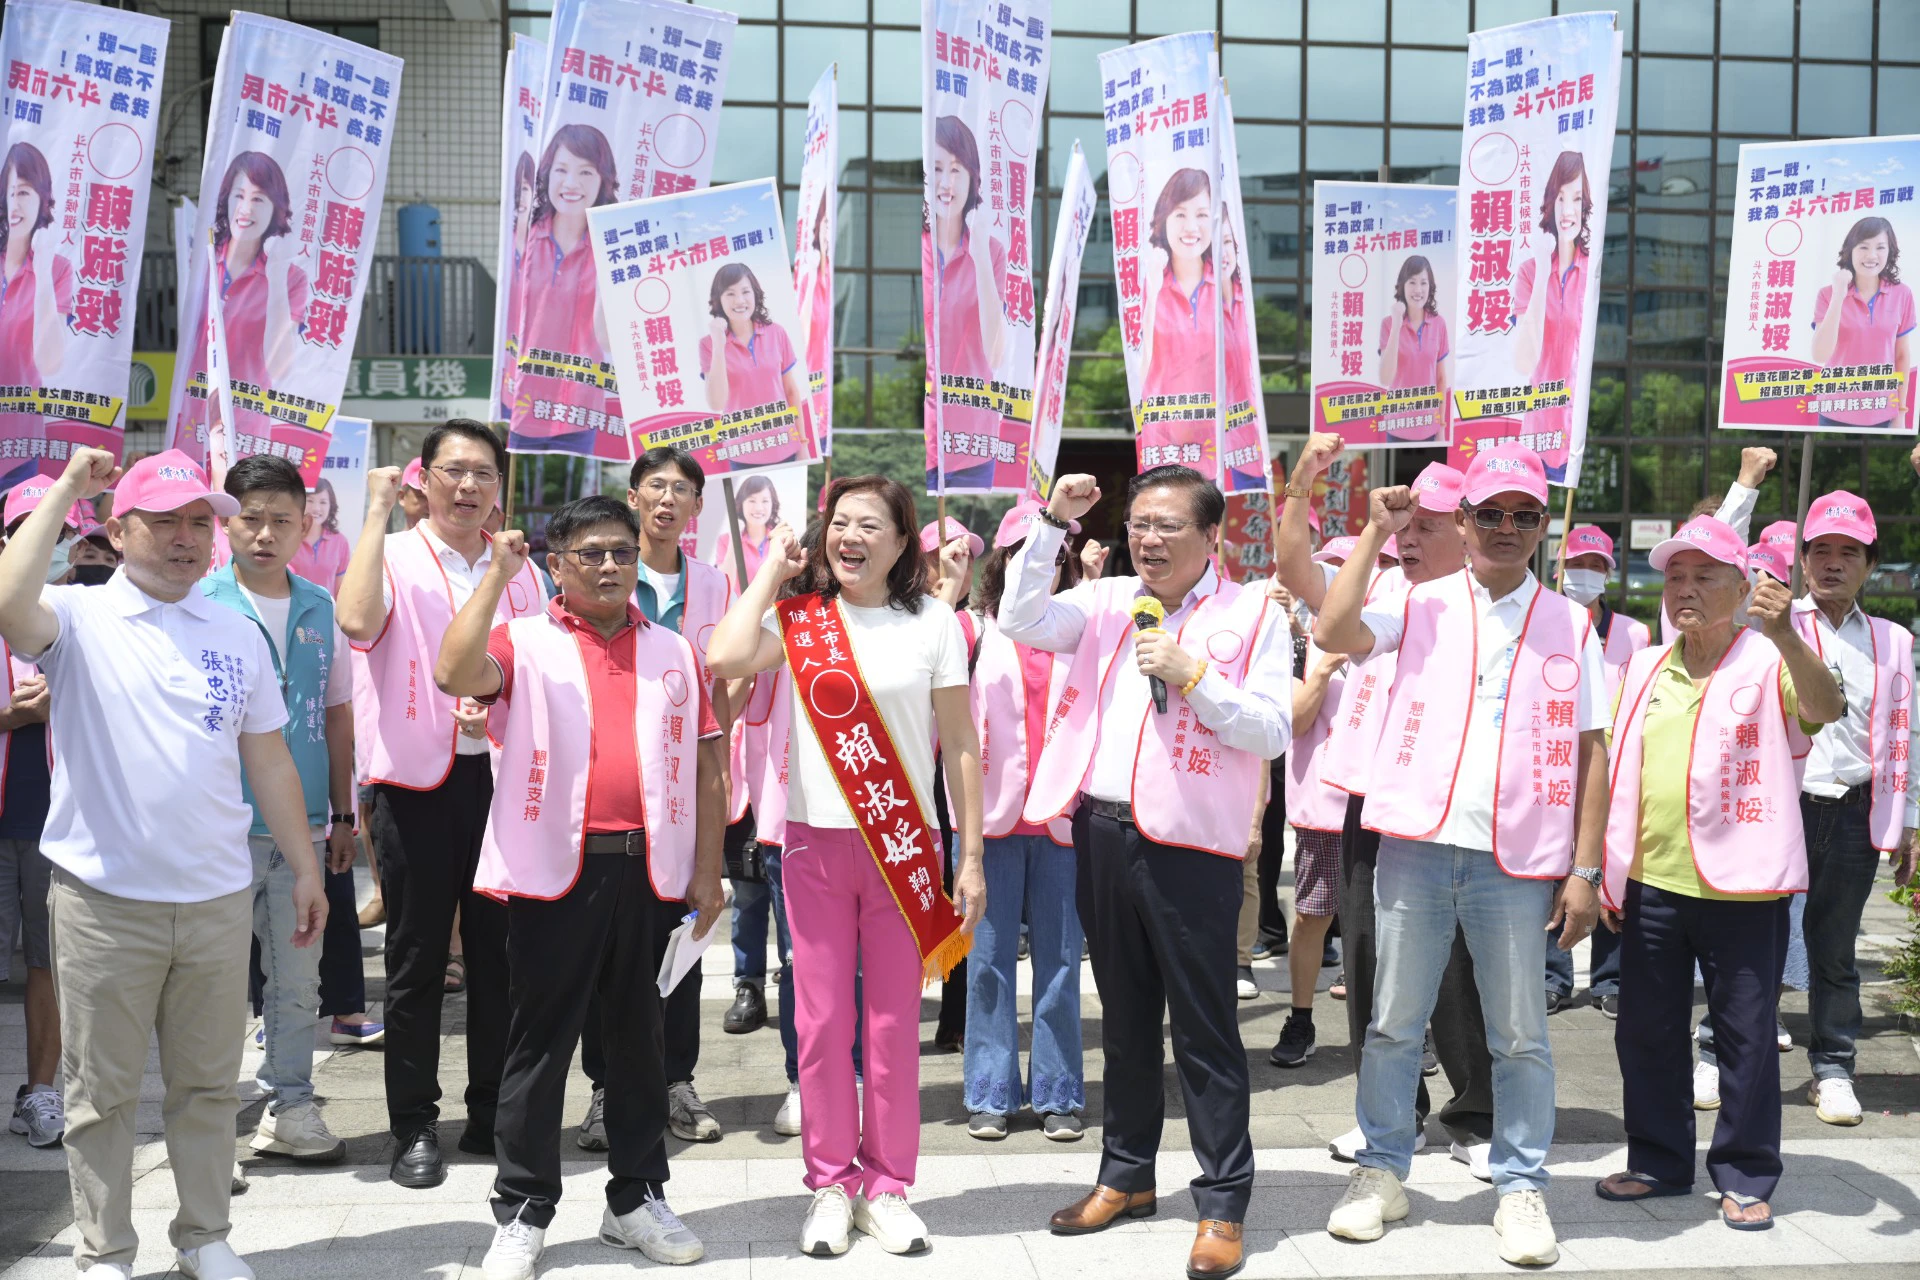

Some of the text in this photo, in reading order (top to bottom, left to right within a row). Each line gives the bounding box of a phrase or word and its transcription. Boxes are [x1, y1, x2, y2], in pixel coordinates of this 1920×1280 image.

[1472, 47, 1534, 78] 這一戰，
[1469, 74, 1595, 126] 我為 斗六市民
[1470, 65, 1552, 101] 不為政黨！
[1106, 93, 1208, 147] 我為 斗六市民
[1558, 108, 1594, 135] 而戰！
[1751, 162, 1811, 183] 這一戰，
[1519, 144, 1532, 249] 斗六市長候選人
[1748, 205, 1779, 222] 我為
[1785, 187, 1875, 219] 斗六市民
[1749, 178, 1826, 203] 不為政黨！
[1325, 201, 1371, 218] 這一戰，
[604, 219, 660, 246] 這一戰，
[1324, 229, 1451, 255] 我為 斗六市民 而戰！
[1325, 218, 1383, 237] 不為政黨！
[607, 232, 680, 265] 不為政黨！
[611, 264, 642, 284] 我為
[648, 235, 730, 275] 斗六市民
[732, 227, 775, 252] 而戰！
[1748, 260, 1762, 332] 斗六市長候選人
[1330, 291, 1339, 358] 斗六市長候選人
[630, 320, 650, 391] 斗六市長候選人
[1744, 364, 1894, 384] 打造花園之都 公益友善城市
[1759, 379, 1899, 398] 招商引資 共創斗六新願景
[1147, 392, 1211, 408] 公益友善城市
[1328, 385, 1436, 408] 打造花園之都 公益友善城市
[1341, 398, 1440, 420] 招商引資 共創斗六新願景
[1465, 385, 1533, 401] 打造花園之都
[1482, 400, 1526, 415] 招商引資
[1807, 397, 1888, 414] 懇請拜託支持
[648, 400, 787, 443] 打造花園之都 公益友善城市
[717, 413, 795, 442] 共創斗六新願景
[788, 609, 822, 672] 候選人
[815, 606, 848, 665] 斗六市長
[201, 649, 229, 732] 張忠豪
[1348, 674, 1377, 730] 懇請支持
[306, 697, 317, 743] 候選人
[1395, 700, 1425, 767] 懇請支持
[1531, 701, 1542, 807] 斗六市市長候選人
[523, 749, 547, 822] 懇請支持
[1719, 727, 1730, 825] 斗六市市長候選人
[908, 866, 934, 912] 鞠躬
